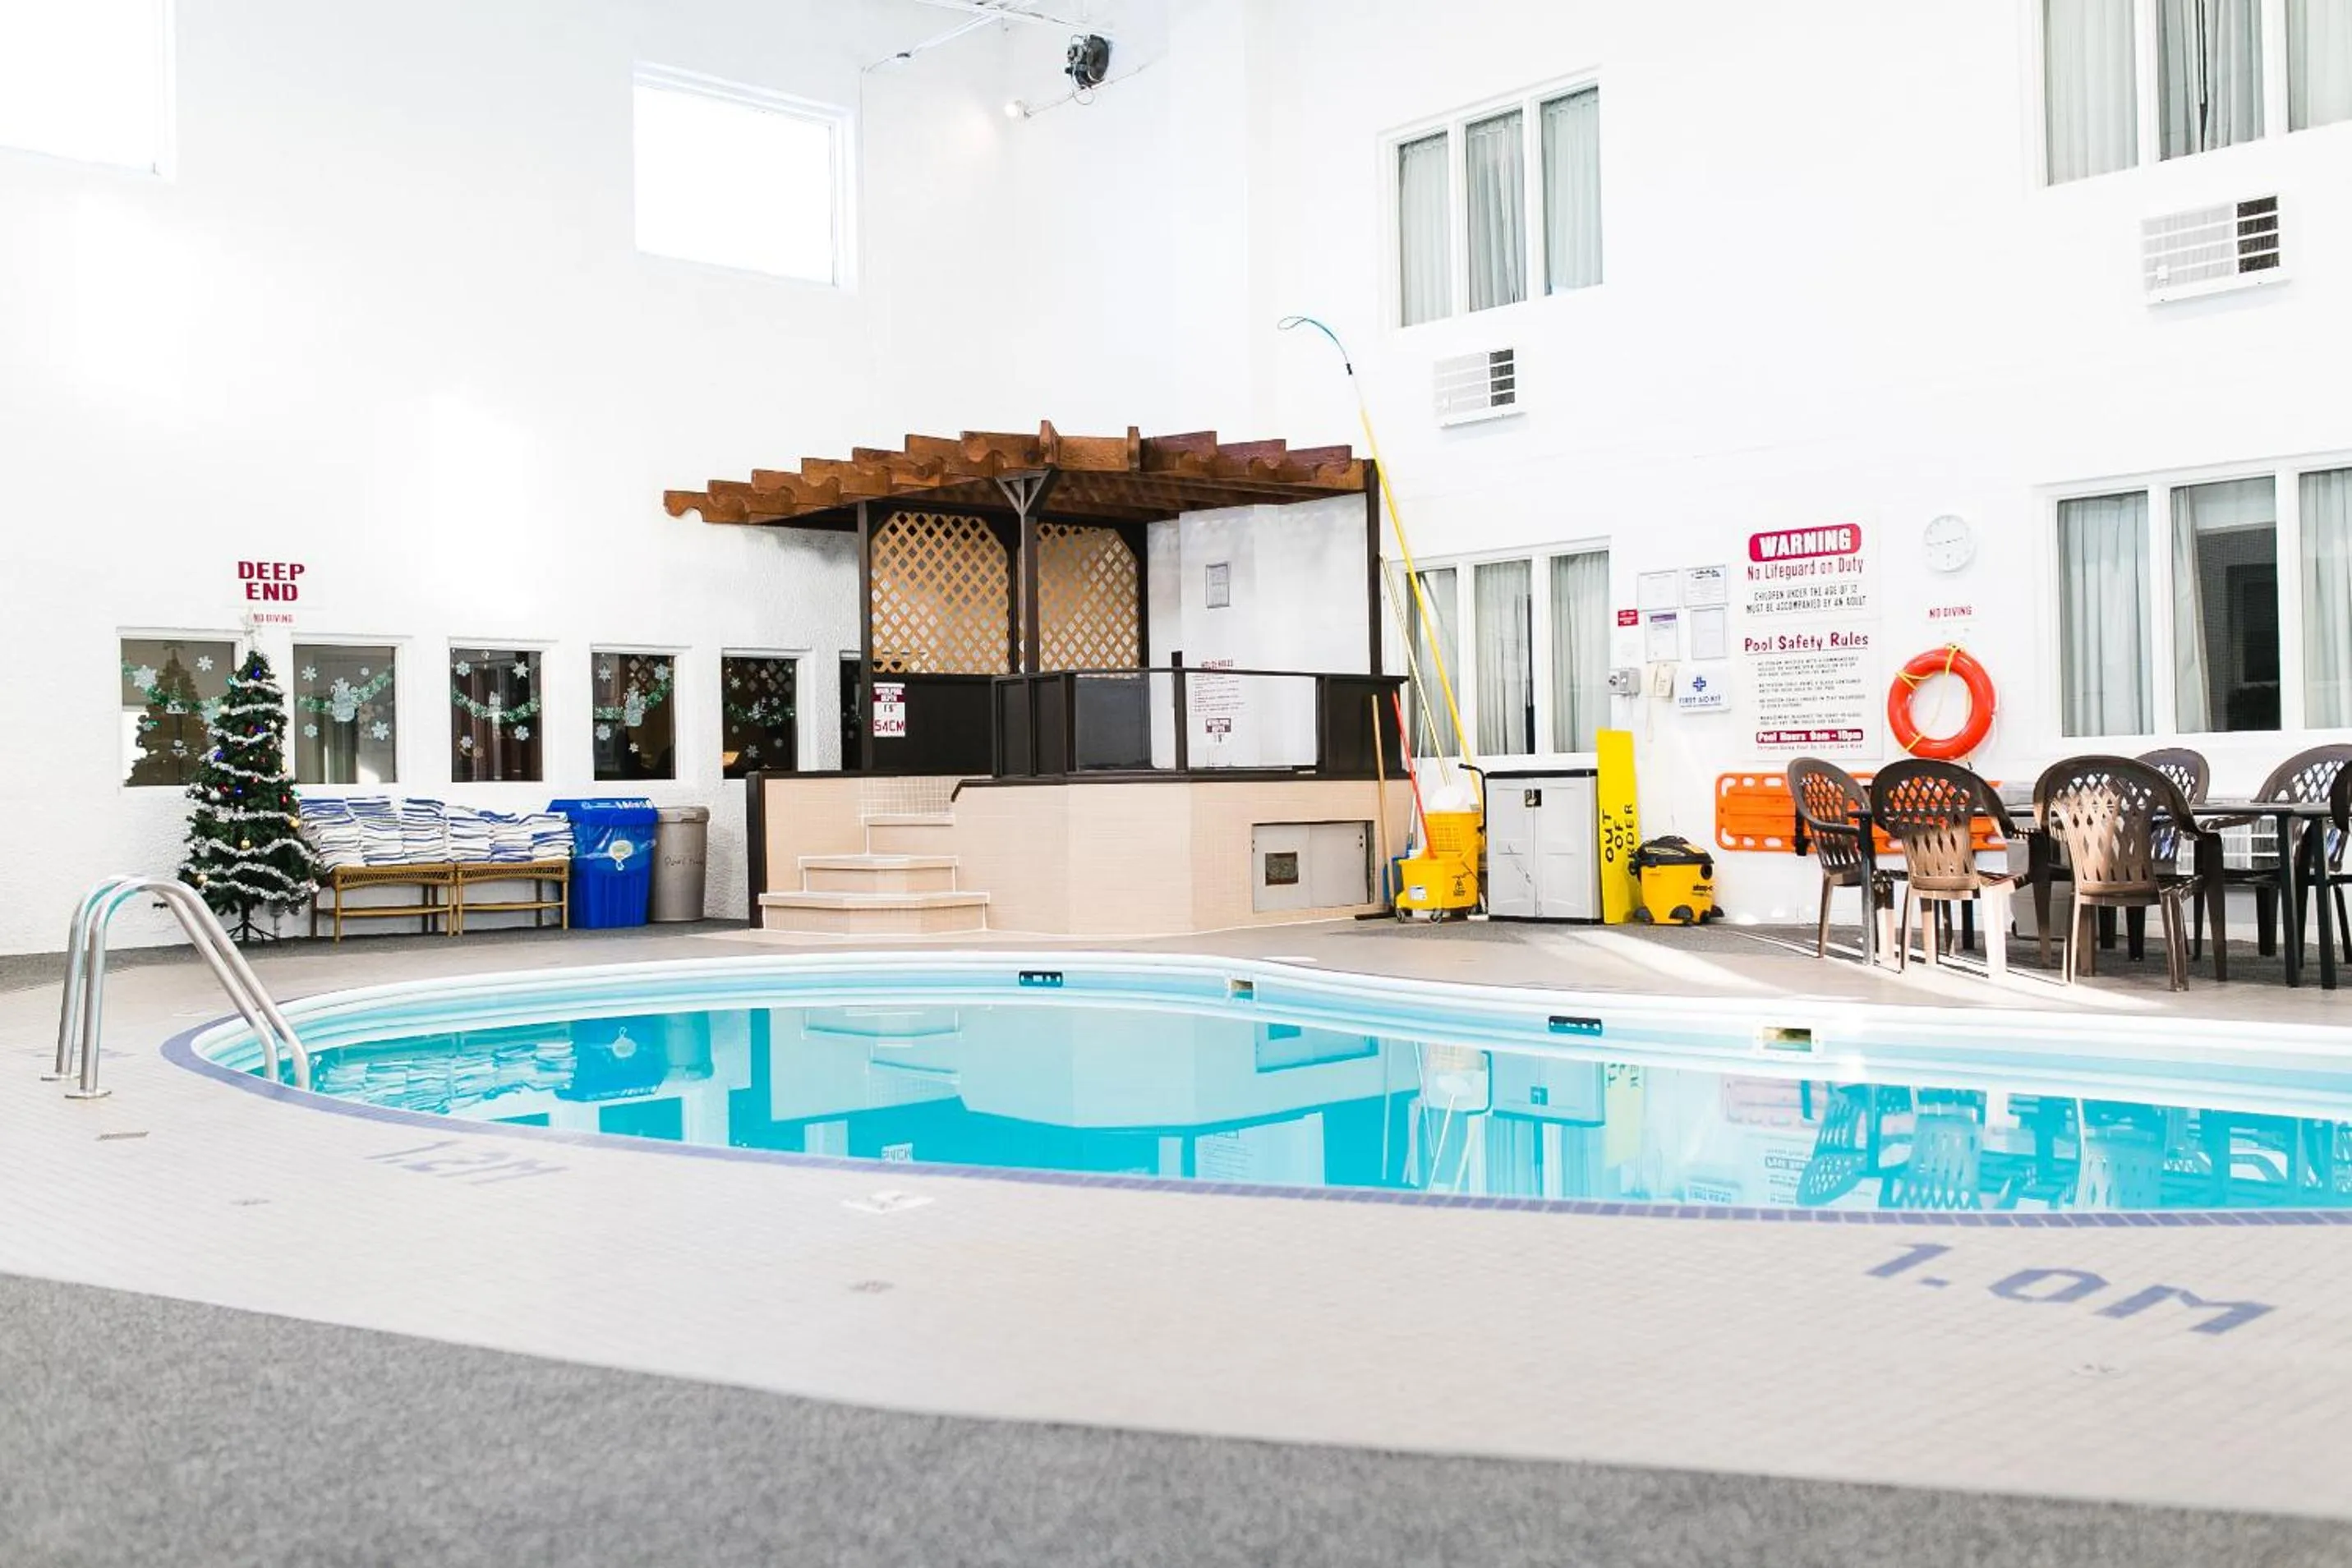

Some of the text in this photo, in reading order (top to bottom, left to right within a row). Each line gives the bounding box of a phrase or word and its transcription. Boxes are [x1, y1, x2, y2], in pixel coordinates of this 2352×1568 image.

[1759, 528, 1852, 559] WARNING
[237, 561, 305, 581] DEEP
[1747, 557, 1863, 581] No Lifeguard on Duty
[246, 582, 298, 601] END
[253, 614, 264, 623] NO
[1929, 606, 1972, 618] NO DIVING
[1744, 632, 1868, 651] Pool Safety Rules
[1602, 808, 1614, 863] OUT
[1613, 819, 1623, 849] OF
[1624, 803, 1637, 876] ORDER
